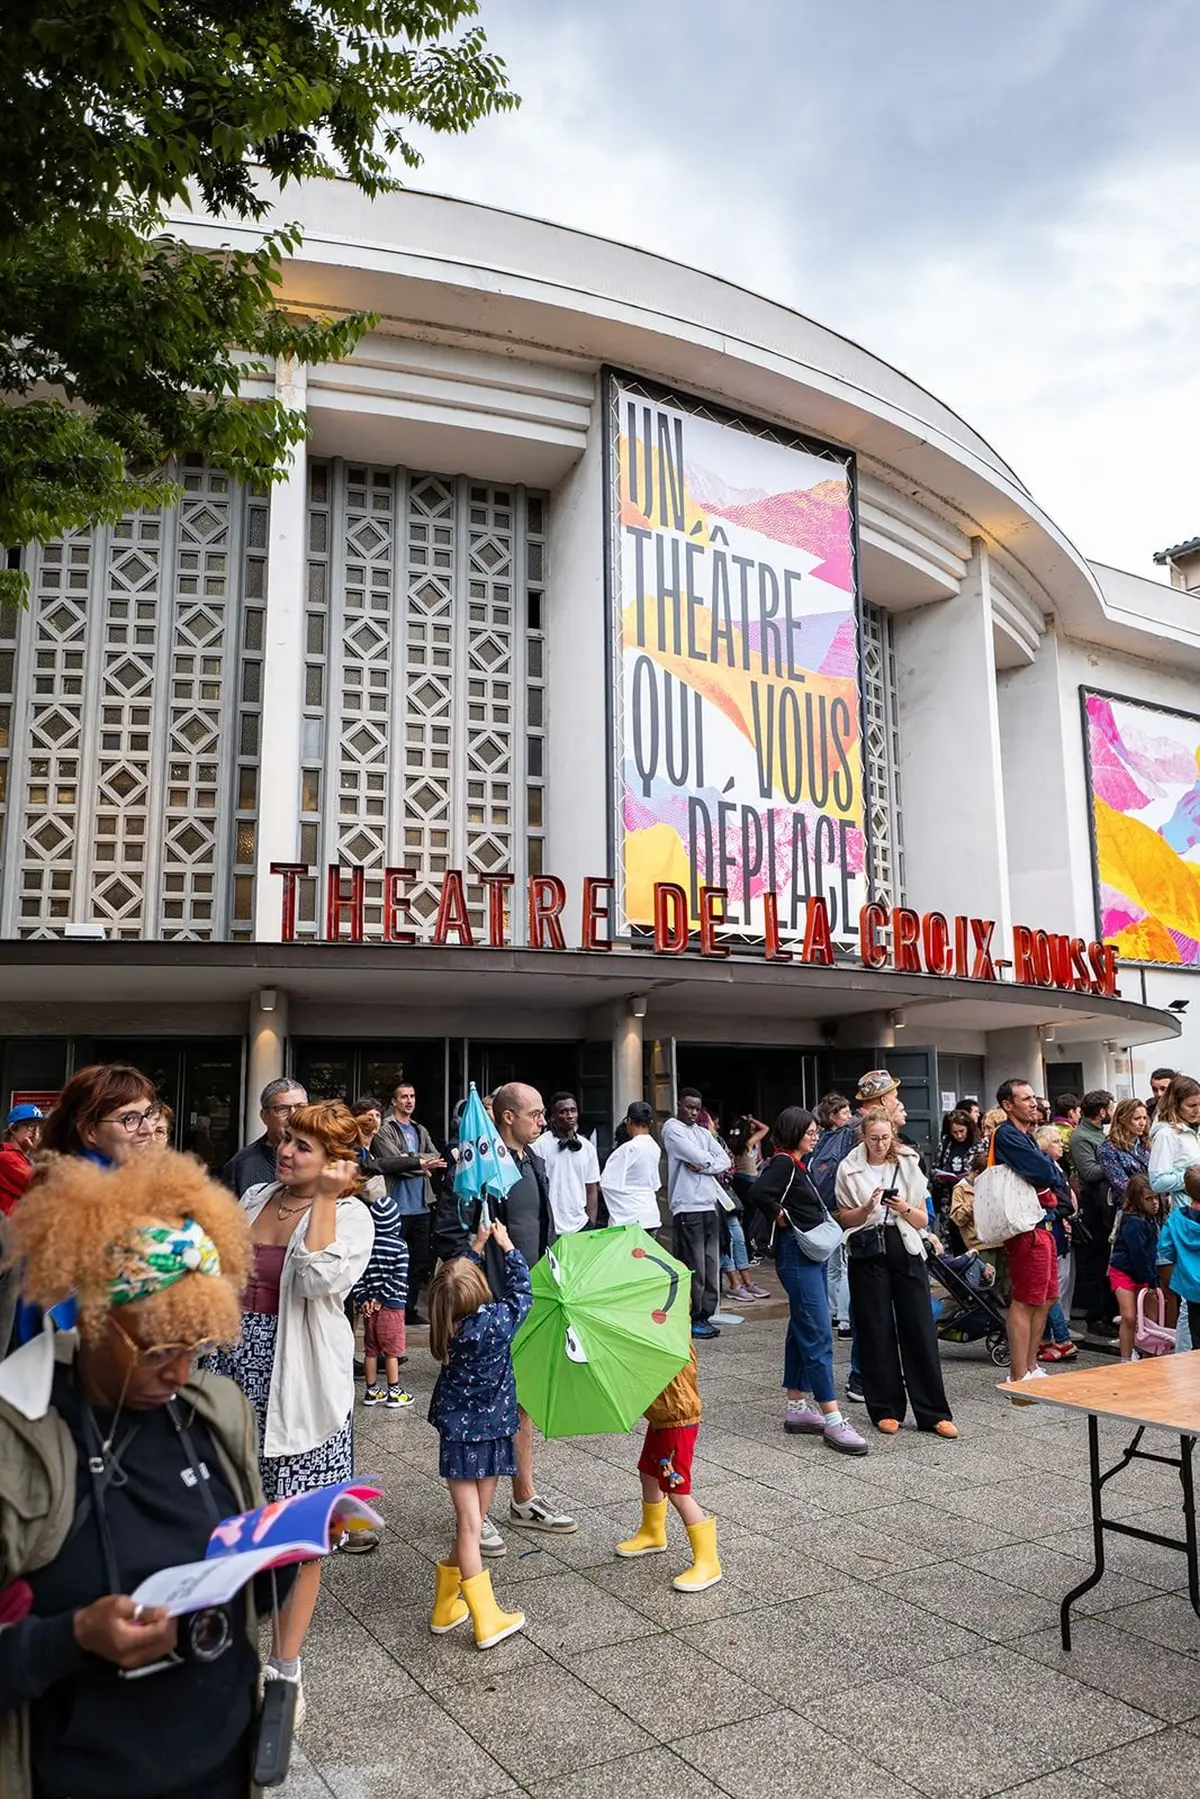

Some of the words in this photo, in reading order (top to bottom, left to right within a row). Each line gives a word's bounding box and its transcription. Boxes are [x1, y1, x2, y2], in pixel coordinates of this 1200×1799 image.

[627, 401, 686, 532] UN
[626, 520, 806, 683] THÉÂTRE
[631, 654, 704, 798] QUI
[750, 680, 853, 813] VOUS
[270, 861, 615, 951] THEATRE
[653, 881, 732, 959] DE
[763, 891, 836, 966] LA
[859, 901, 1123, 999] CROIX-ROUSSE
[688, 775, 860, 935] DÉPLACE
